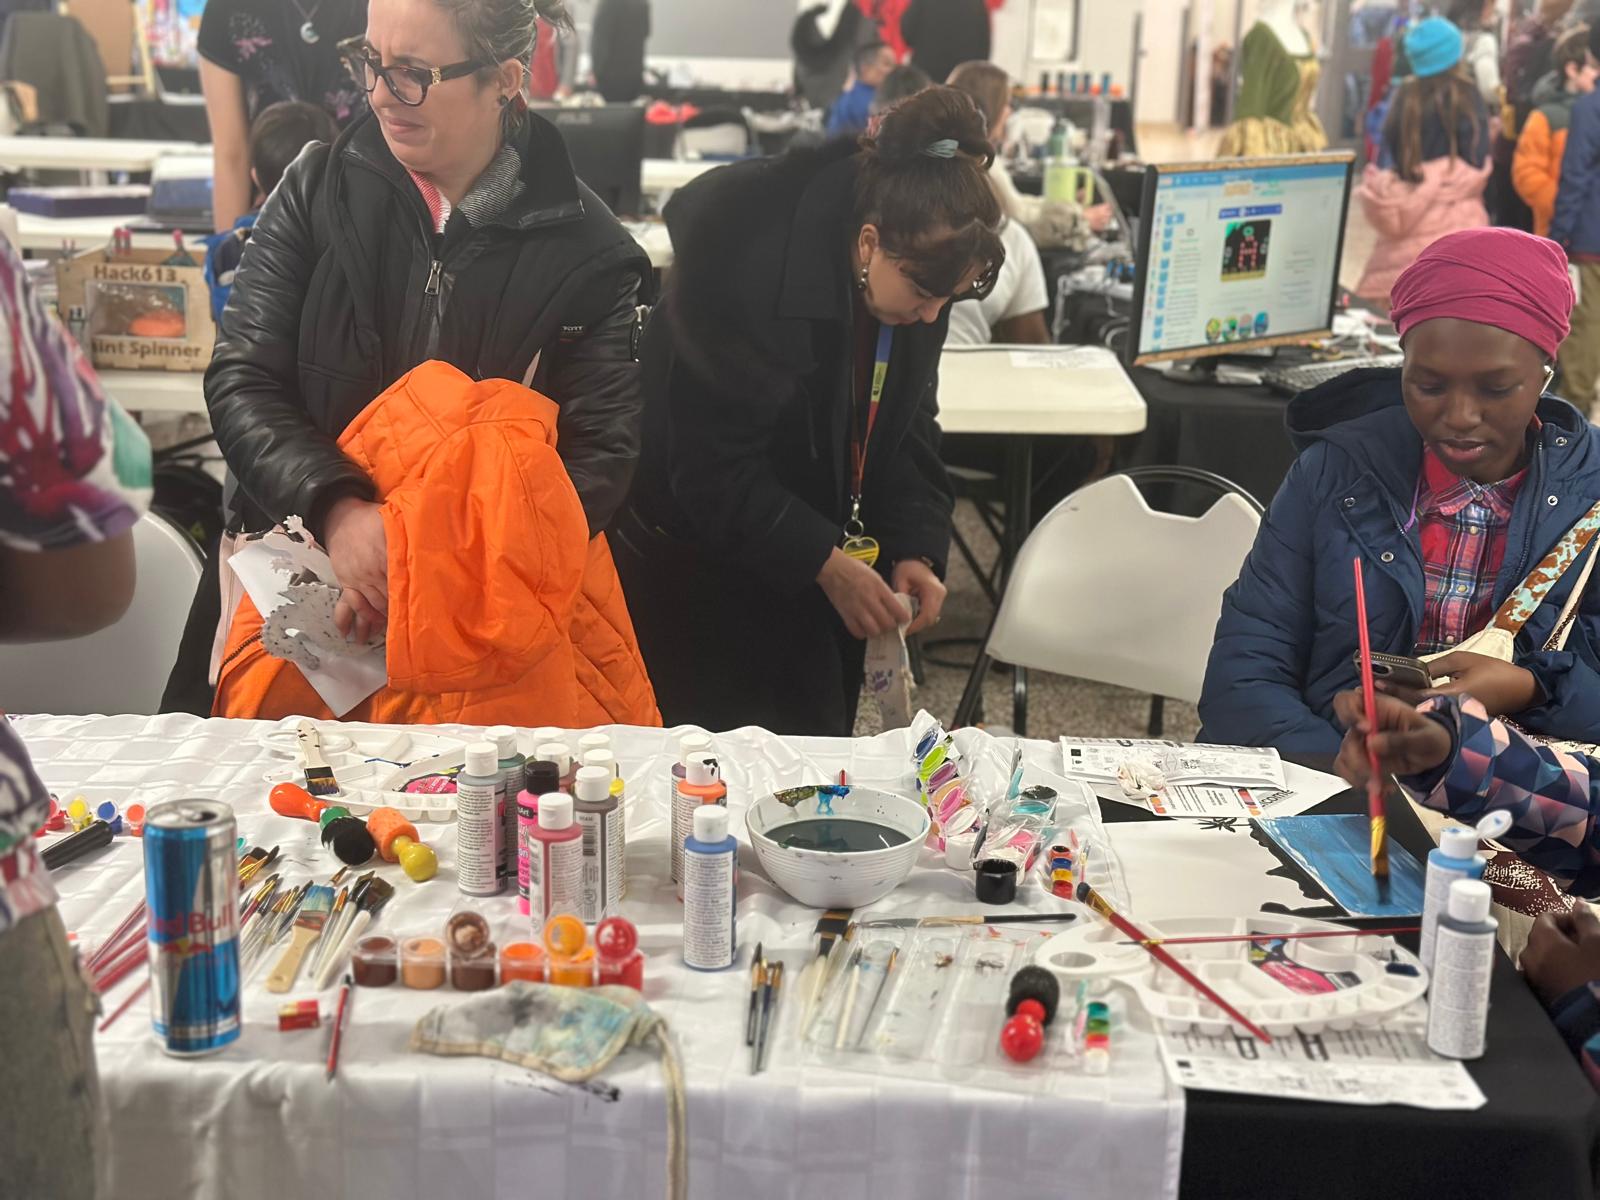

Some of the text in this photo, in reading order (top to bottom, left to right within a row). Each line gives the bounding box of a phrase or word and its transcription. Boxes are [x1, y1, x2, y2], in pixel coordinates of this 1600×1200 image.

[94, 265, 177, 282] Hack613
[129, 341, 201, 358] Spinner
[1259, 789, 1295, 808] come
[148, 902, 235, 936] Red Bull
